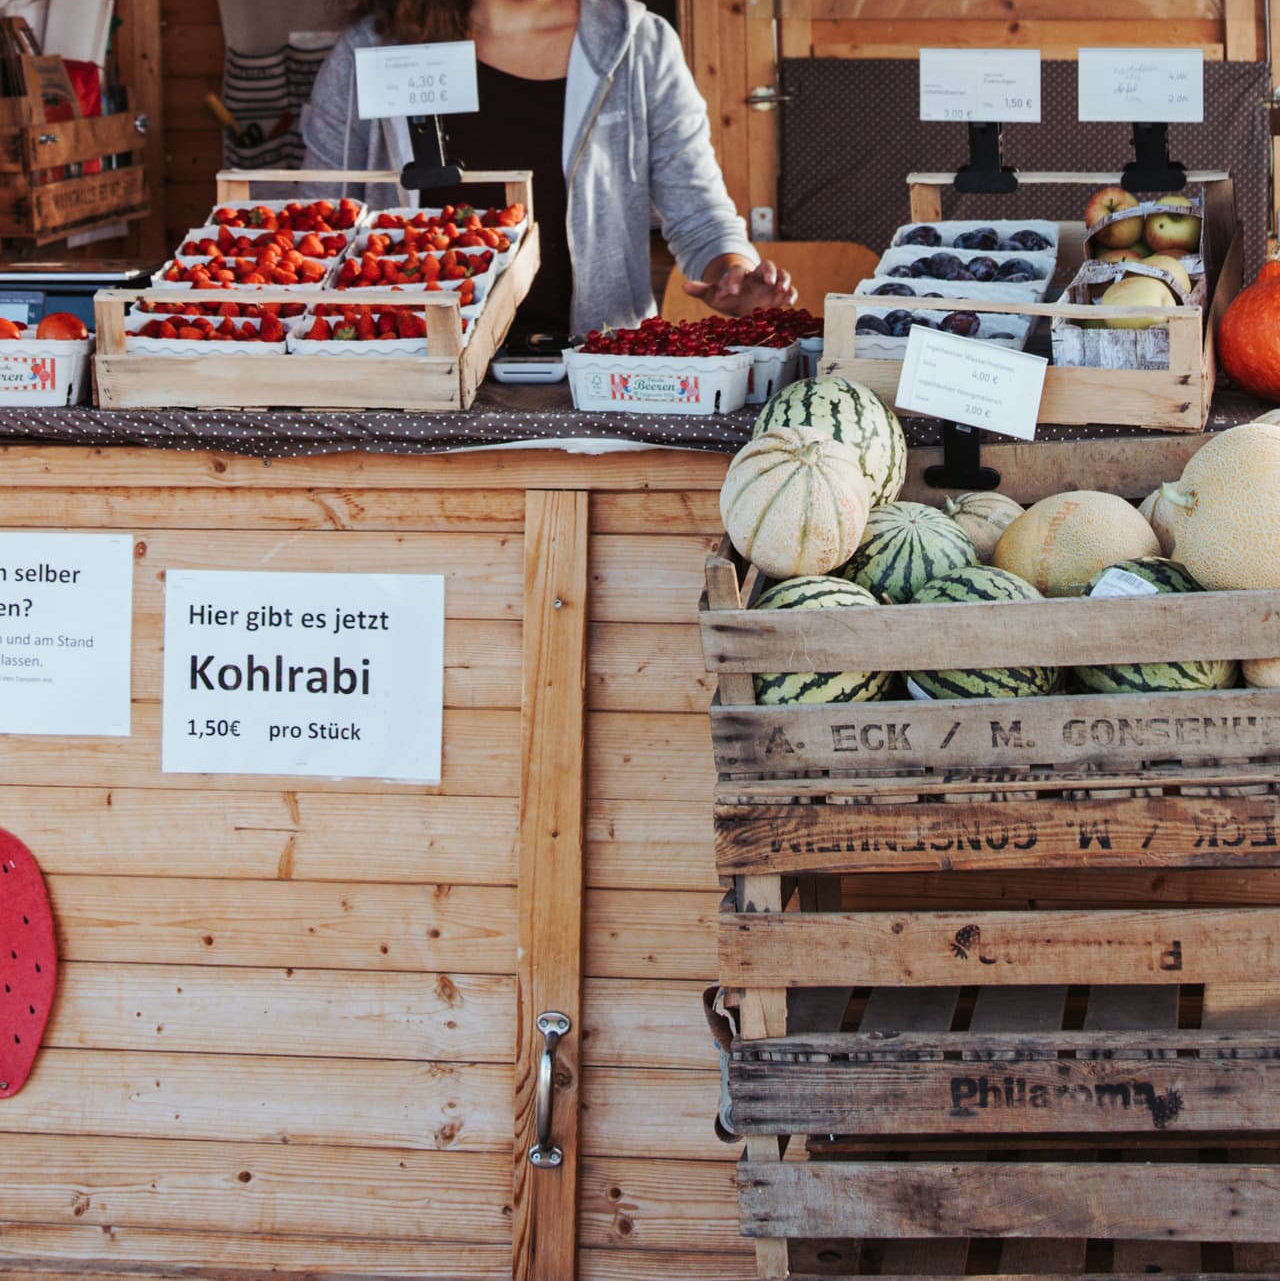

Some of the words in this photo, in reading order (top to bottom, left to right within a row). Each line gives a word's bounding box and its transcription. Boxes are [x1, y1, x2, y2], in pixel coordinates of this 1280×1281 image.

[438, 73, 448, 87] €
[440, 90, 449, 103] €
[1026, 98, 1033, 109] €
[967, 109, 974, 119] €
[971, 370, 990, 383] 4,00
[992, 376, 1001, 385] €
[633, 379, 676, 392] Beeren
[984, 409, 992, 419] €
[14, 564, 81, 583] selber
[188, 604, 239, 626] Hier
[246, 605, 293, 632] gibt
[300, 612, 327, 628] es
[333, 608, 389, 634] jetzt
[6, 633, 31, 646] und
[34, 637, 54, 647] am
[57, 635, 94, 648] Stand
[0, 653, 44, 668] lassen.
[190, 654, 370, 695] Kohlrabi
[187, 719, 241, 739] 1,50€
[269, 724, 302, 742] pro
[308, 722, 362, 741] Stück
[765, 725, 806, 755] A.
[830, 722, 913, 752] ECK
[990, 720, 1037, 749] M.
